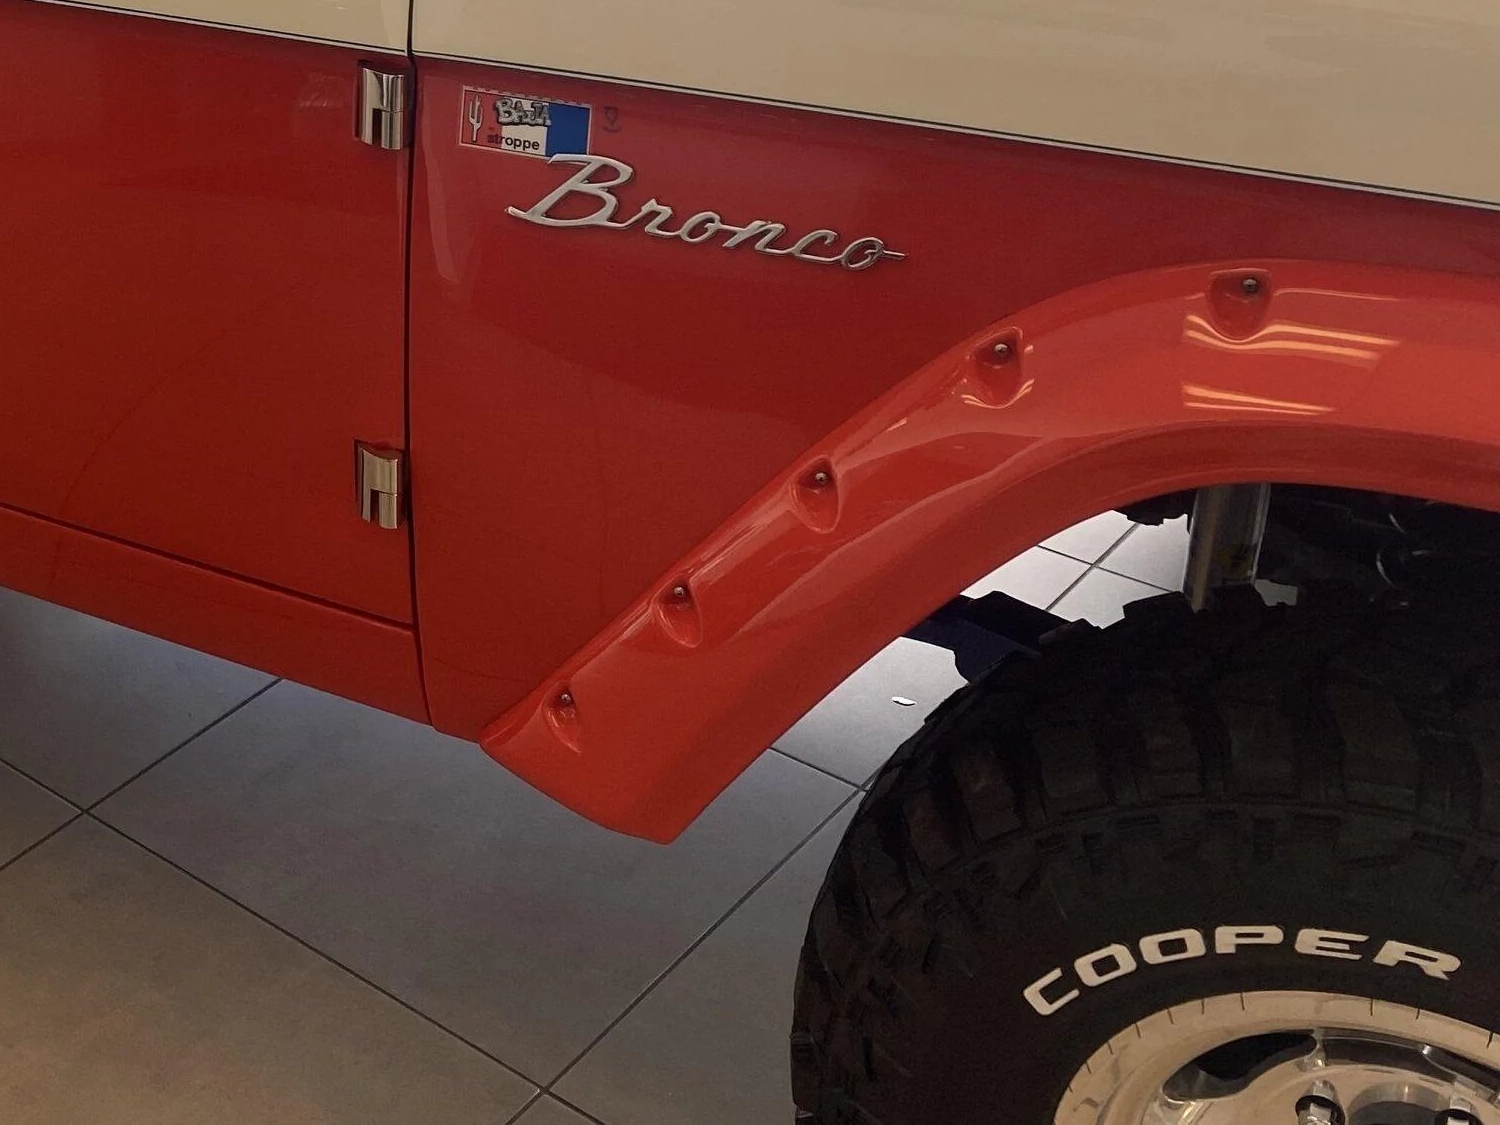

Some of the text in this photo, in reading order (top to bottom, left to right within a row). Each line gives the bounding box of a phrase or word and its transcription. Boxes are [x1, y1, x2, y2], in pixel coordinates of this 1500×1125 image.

[487, 133, 540, 151] stroppe
[494, 97, 552, 127] BAJA
[504, 152, 911, 272] Bronco
[1022, 924, 1463, 1017] COOPER
